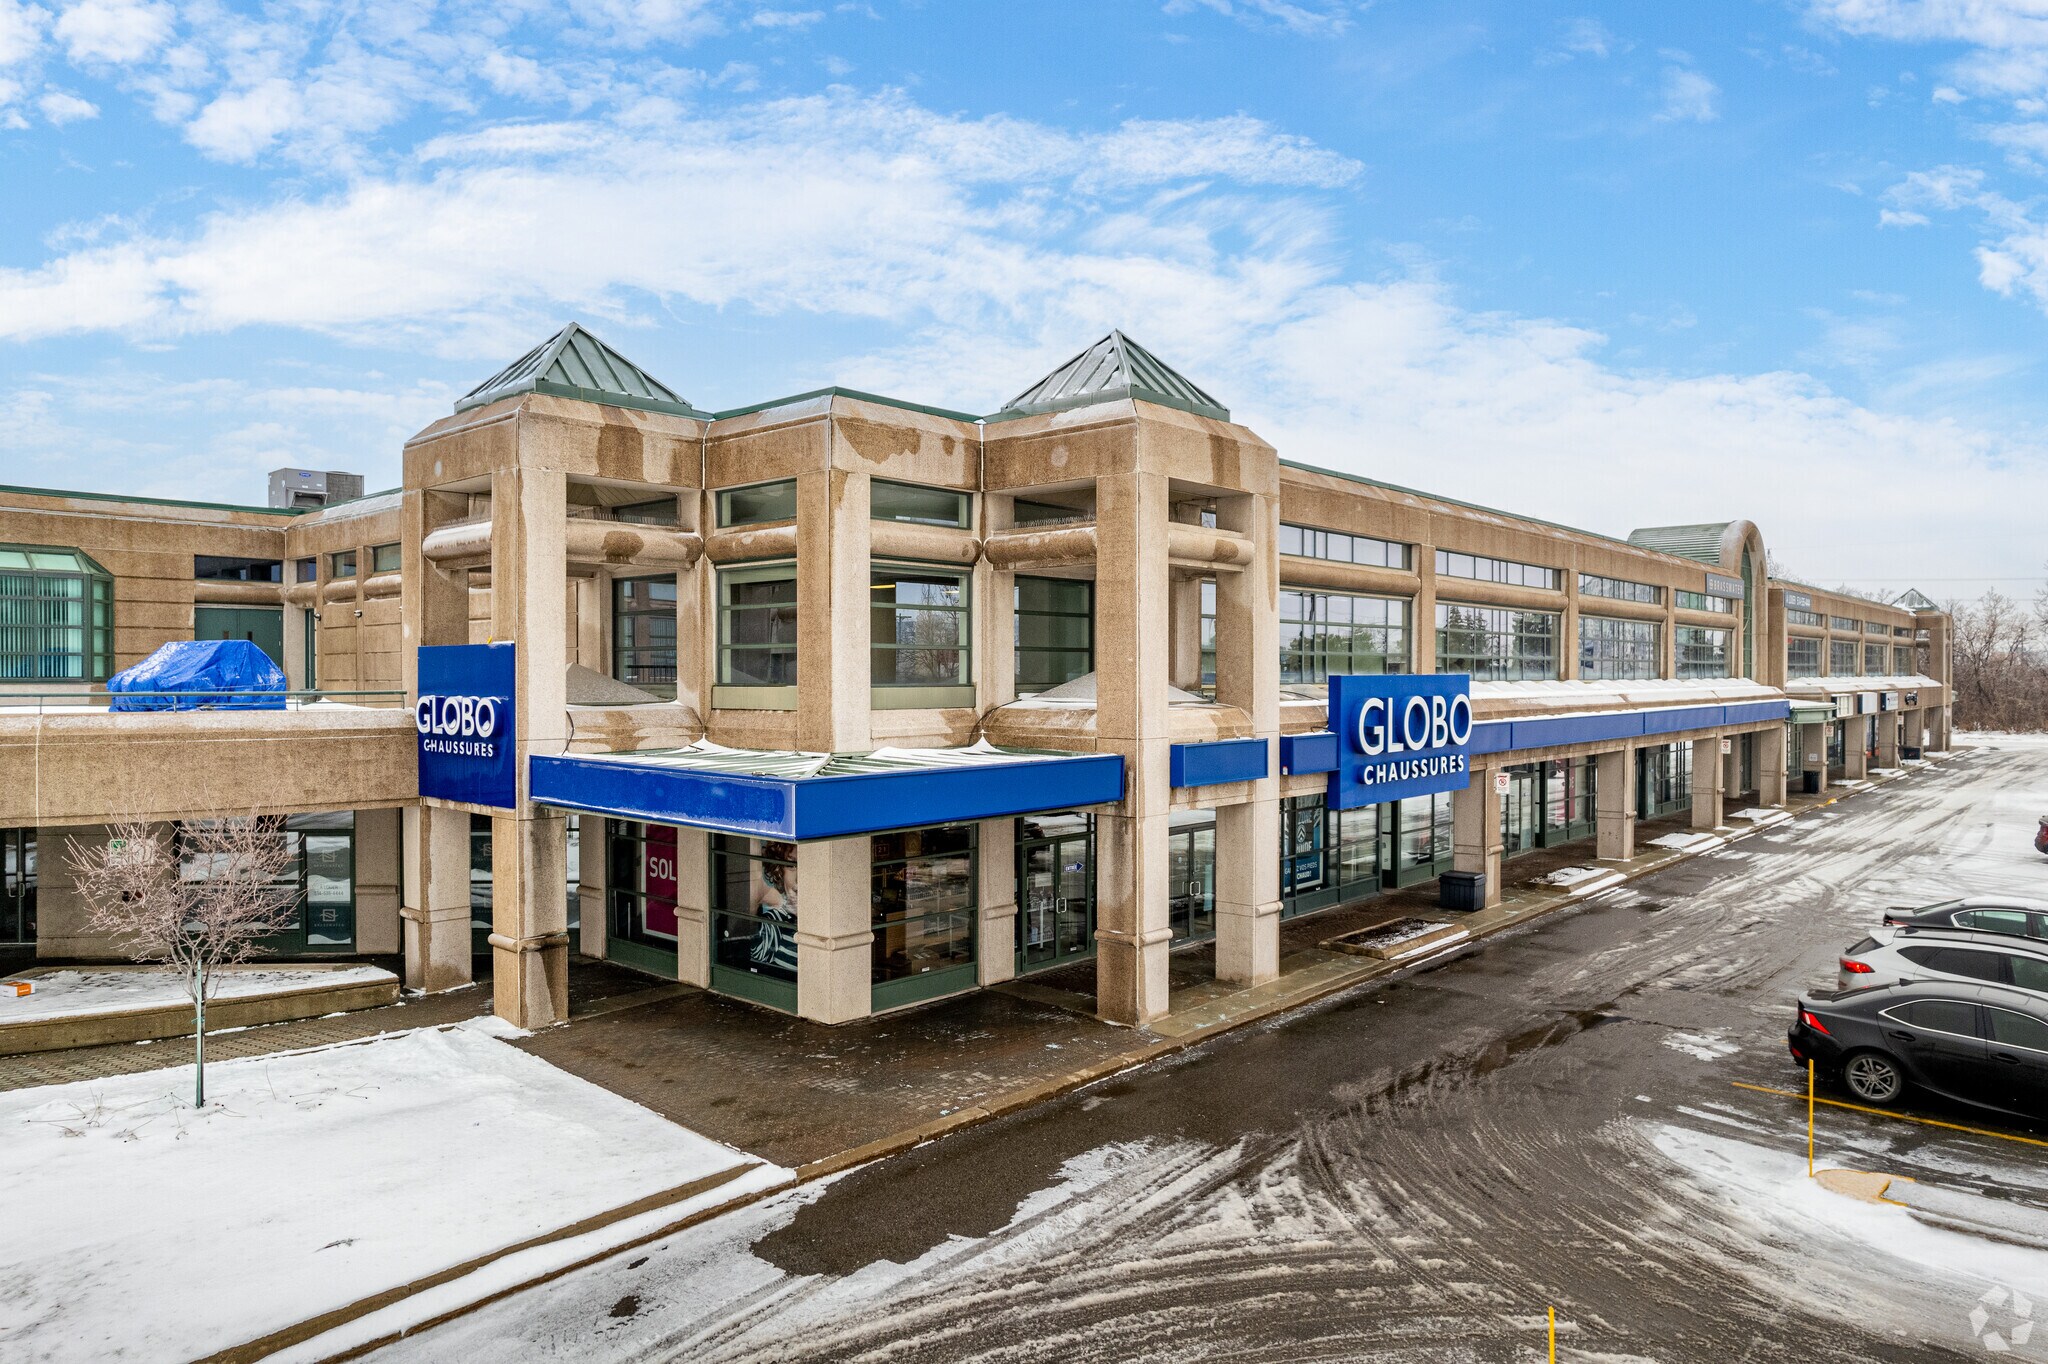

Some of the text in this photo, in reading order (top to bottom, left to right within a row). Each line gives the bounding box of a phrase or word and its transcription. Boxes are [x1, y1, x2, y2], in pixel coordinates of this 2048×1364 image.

[416, 695, 495, 738] GLOBO
[1359, 694, 1473, 756] GLOBO
[424, 739, 494, 757] CHAUSSURES
[1364, 754, 1464, 785] CHAUSSURES
[650, 856, 677, 881] SOL
